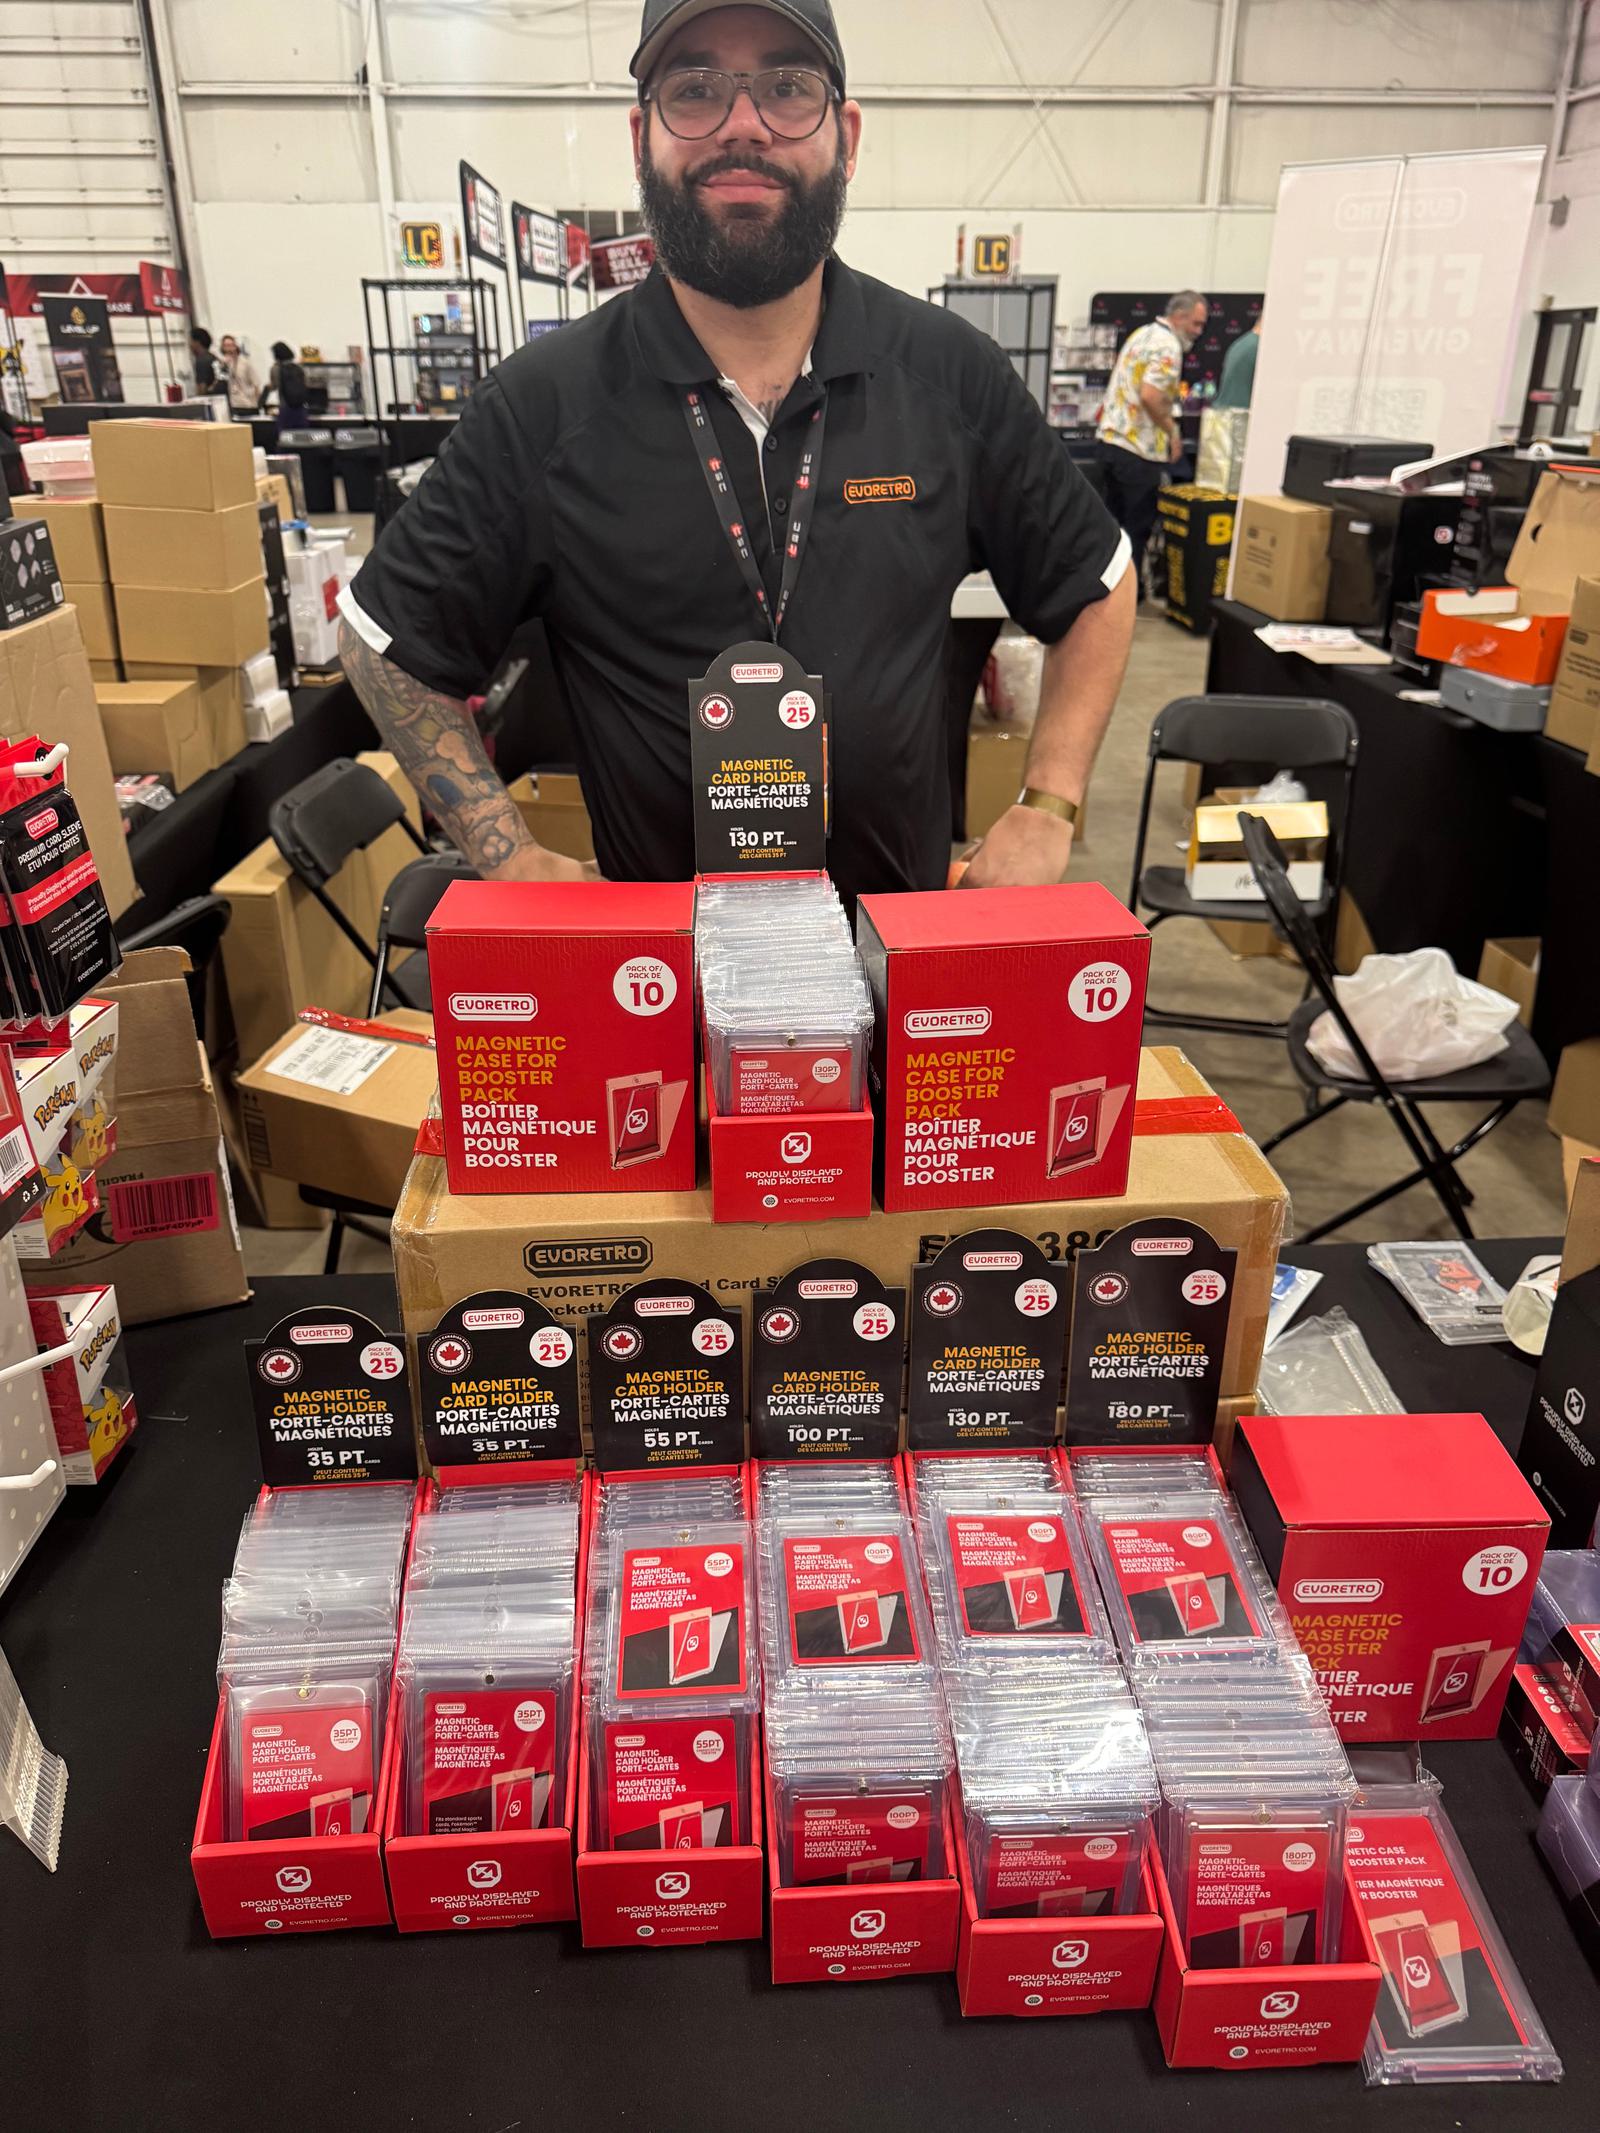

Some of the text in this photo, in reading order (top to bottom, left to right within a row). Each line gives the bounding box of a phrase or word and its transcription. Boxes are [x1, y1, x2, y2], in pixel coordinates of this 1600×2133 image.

[407, 228, 437, 261] LC
[979, 241, 1006, 272] LC
[848, 482, 911, 498] EVORETRO
[736, 668, 778, 676] EVORETRO
[787, 707, 810, 722] 25
[721, 759, 793, 771] MAGNETIC
[712, 772, 805, 784] CARD HOLDER
[708, 784, 811, 797] PORTE-CARTES
[711, 795, 808, 810] MAGNÉTIQUES
[29, 812, 55, 833] EVORETRO
[18, 821, 82, 866] PREMIUM CARD SLEEVE
[729, 832, 784, 846] 130 PT
[28, 835, 80, 872] ETUI POUR CARTES
[630, 982, 663, 1006] 10
[1085, 987, 1117, 1013] 10
[457, 1000, 530, 1011] EVORETRO
[912, 1015, 984, 1028] EVORETRO
[456, 1036, 566, 1051] MAGNETIC
[458, 1054, 557, 1068] CASE FOR
[907, 1048, 1016, 1069] MAGNETIC
[459, 1071, 553, 1085] BOOSTER
[906, 1067, 1004, 1086] CASE FOR
[460, 1087, 517, 1102] PACK
[906, 1084, 999, 1103] BOOSTER
[461, 1101, 539, 1119] BOÎTIER
[906, 1103, 960, 1119] PACK
[463, 1117, 596, 1136] MAGNÉTIQUE
[905, 1118, 981, 1136] BOÎTIER
[464, 1138, 519, 1151] POUR
[905, 1129, 1036, 1153] MAGNÉTIQUE
[466, 1154, 557, 1168] BOOSTER
[905, 1154, 958, 1169] POUR
[746, 1168, 842, 1179] PROUDLY DISPLAYED
[904, 1167, 994, 1186] BOOSTER
[780, 1177, 834, 1185] PROTECTED
[535, 1245, 642, 1264] EVORETRO
[716, 1277, 760, 1291] Card
[804, 1284, 852, 1292] EVORETRO
[1190, 1285, 1218, 1300] 25
[1024, 1296, 1050, 1311] 25
[468, 1313, 519, 1322] EVORETRO
[296, 1329, 348, 1337] EVORETRO
[862, 1319, 888, 1334] 25
[701, 1334, 727, 1350] 25
[1107, 1332, 1192, 1343] MAGNETIC
[540, 1344, 566, 1361] 25
[944, 1346, 1026, 1357] MAGNETIC
[1095, 1344, 1205, 1355] CARD HOLDER
[370, 1358, 398, 1373] 25
[933, 1358, 1040, 1370] CARD HOLDER
[1089, 1355, 1209, 1367] PORTE-CARTES
[626, 1370, 709, 1384] MAGNETIC
[784, 1371, 866, 1382] MAGNETIC
[928, 1369, 1044, 1381] PORTE-CARTES
[1092, 1366, 1204, 1378] MAGNÉTIQUES
[452, 1378, 538, 1394] MAGNETIC
[616, 1382, 724, 1396] CARD HOLDER
[772, 1382, 879, 1393] CARD HOLDER
[930, 1379, 1040, 1393] MAGNÉTIQUES
[284, 1389, 370, 1403] MAGNETIC
[441, 1391, 553, 1408] CARD HOLDER
[611, 1394, 730, 1410] PORTE-CARTES
[767, 1393, 884, 1404] PORTE-CARTES
[274, 1401, 387, 1416] CARD HOLDER
[436, 1404, 560, 1422] PORTE-CARTES
[615, 1407, 726, 1423] MAGNÉTIQUES
[770, 1403, 880, 1416] MAGNÉTIQUES
[1108, 1406, 1172, 1418] 180 PT
[270, 1413, 393, 1429] PORTE-CARTES
[440, 1418, 556, 1435] MAGNÉTIQUES
[948, 1413, 1010, 1426] 130 PT
[276, 1426, 392, 1442] MAGNÉTIQUES
[644, 1432, 699, 1447] 55 PT
[788, 1428, 850, 1442] 100 PT
[473, 1439, 529, 1452] 35 PT
[308, 1451, 364, 1466] 35 PT
[1479, 1567, 1512, 1588] 10
[1302, 1584, 1376, 1594] EVORETRO
[1292, 1614, 1402, 1627] MAGNETIC
[1349, 1628, 1388, 1640] FOR
[334, 1729, 358, 1738] 35PT
[253, 1739, 296, 1749] MAGNETIC
[253, 1746, 310, 1756] CARD HOLDER
[253, 1753, 316, 1764] PORTE-CARTES
[1349, 1857, 1426, 1866] BOOSTER PACK
[1376, 1878, 1444, 1888] MAGNÉTIQUE
[1370, 1891, 1418, 1899] BOOSTER
[1214, 2022, 1331, 2033] PROUDLY DISPLAYED
[1254, 2029, 1319, 2038] PROTECTED
